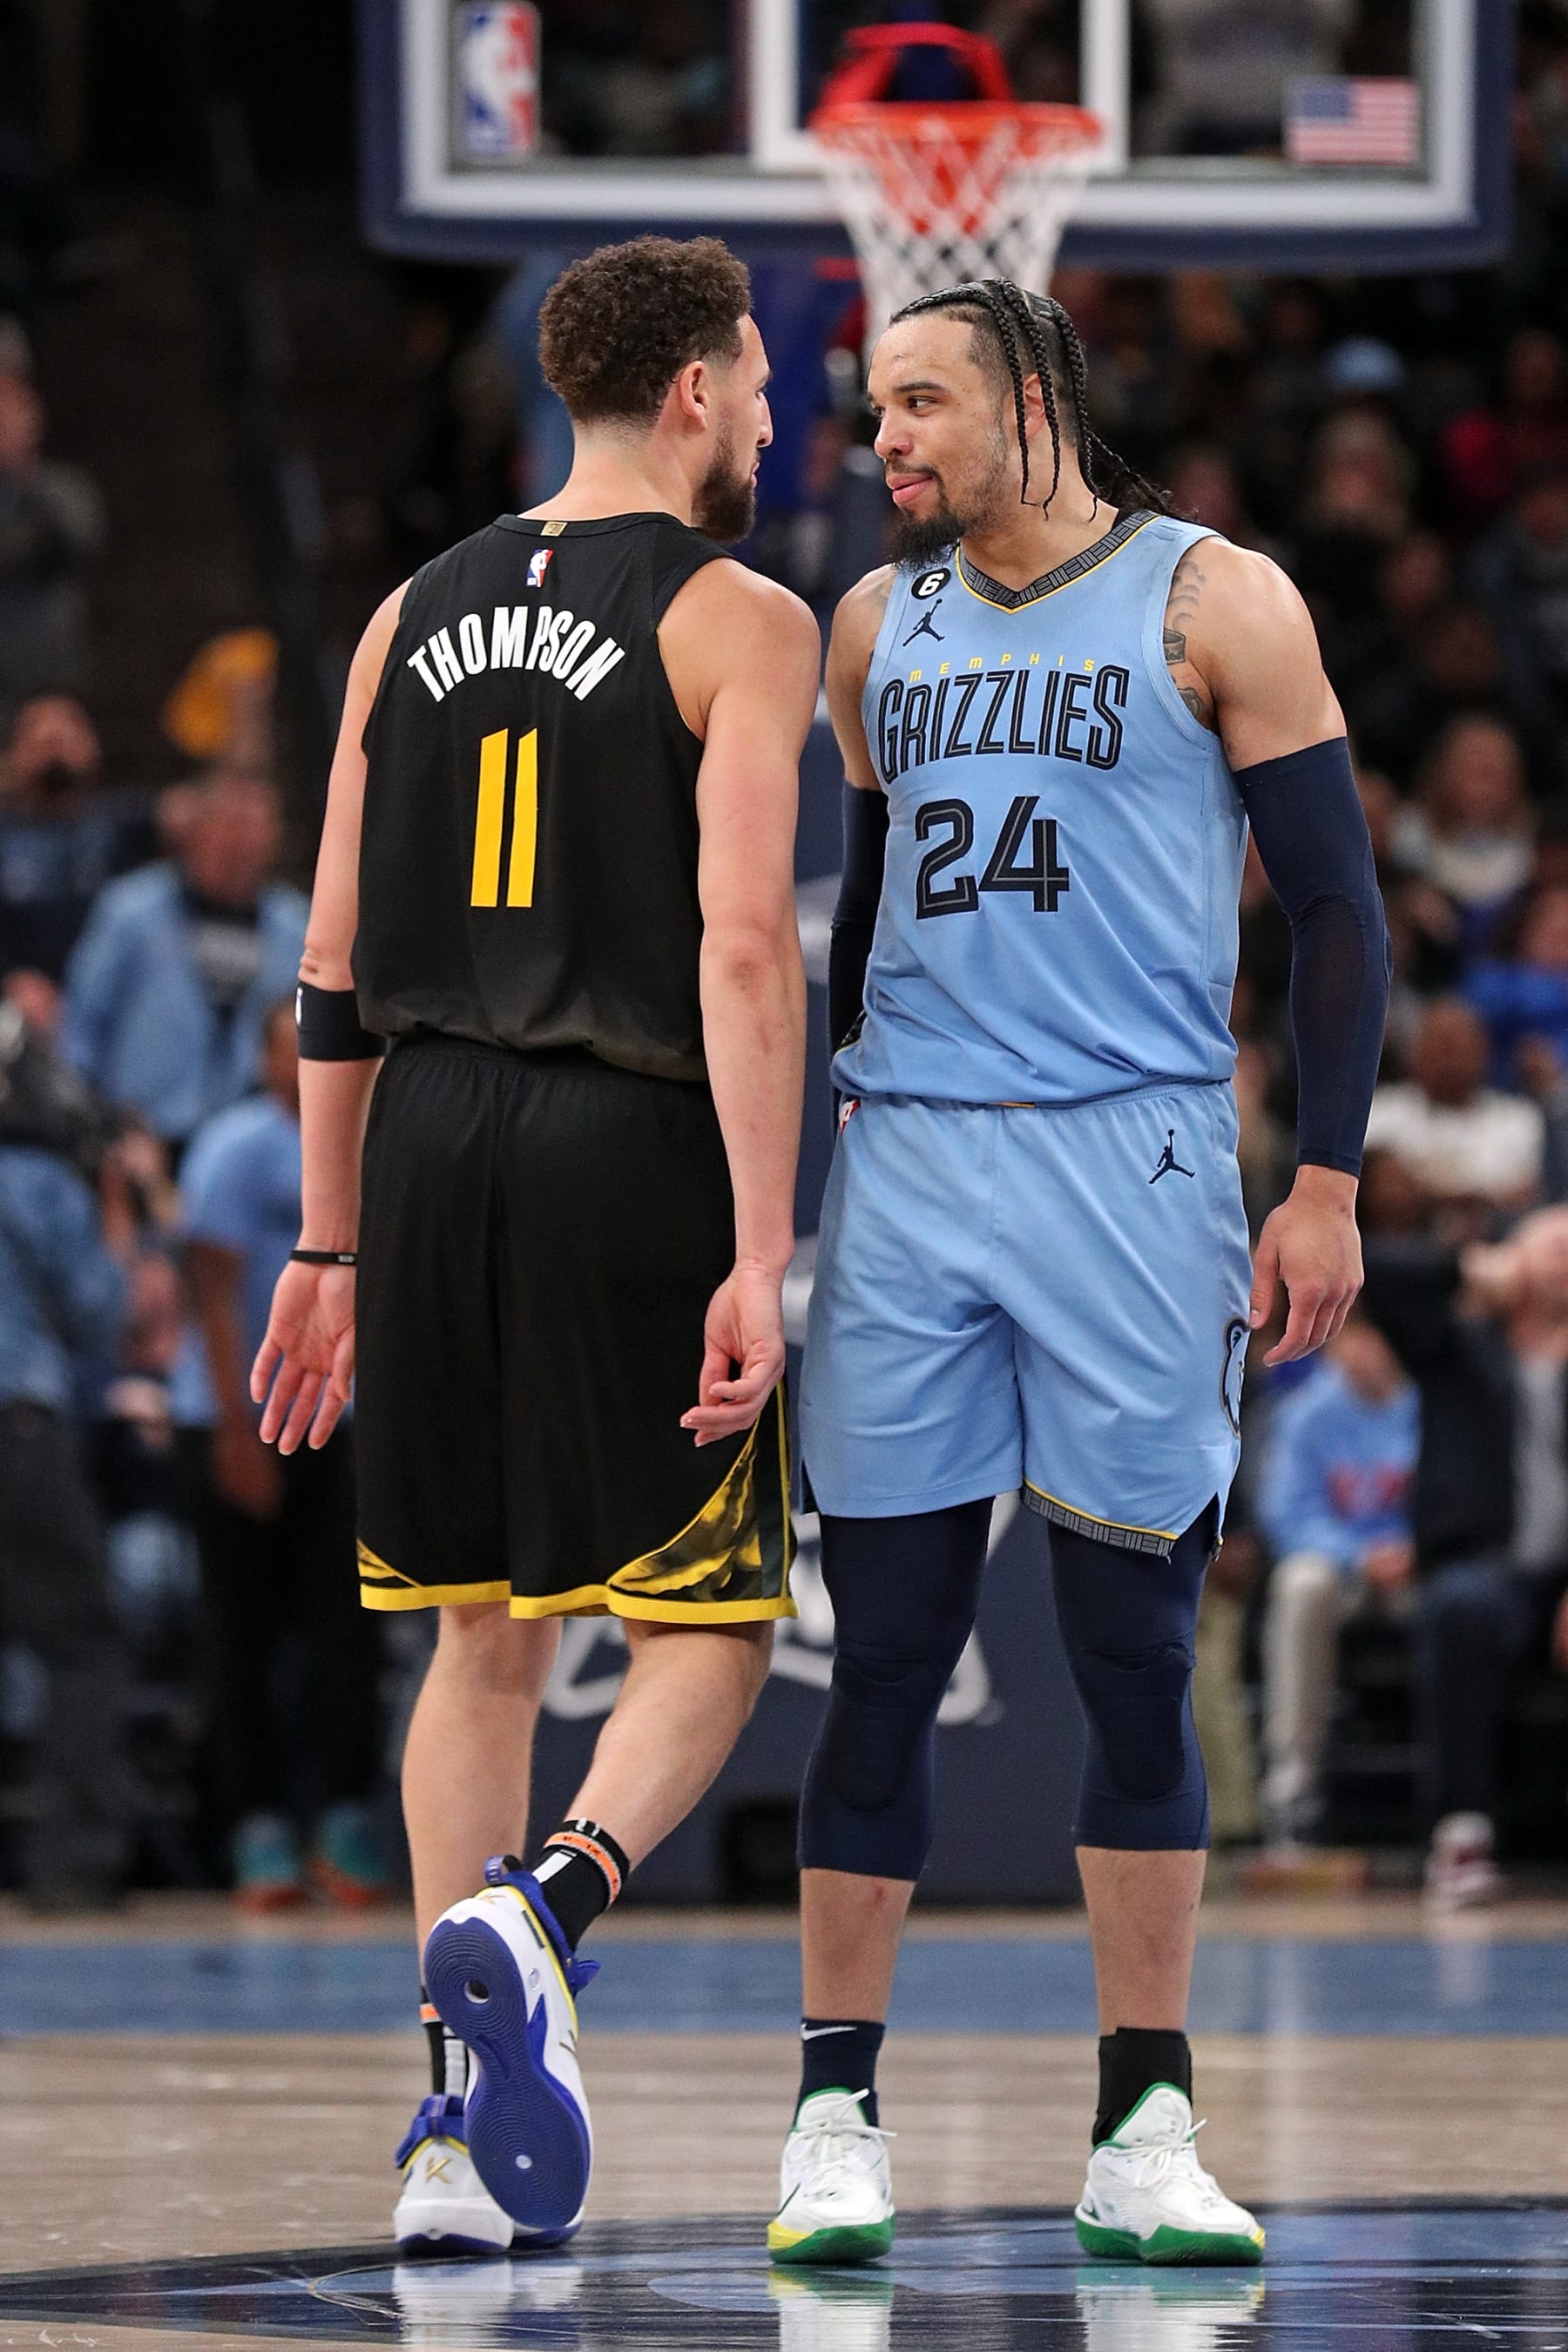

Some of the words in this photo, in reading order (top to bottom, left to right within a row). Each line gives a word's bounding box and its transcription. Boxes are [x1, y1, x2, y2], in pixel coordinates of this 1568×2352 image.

[918, 572, 944, 596] 6
[407, 605, 625, 703] THOMPSON
[909, 652, 1095, 684] MEMPHIS
[877, 665, 1130, 785] GRIZZLIES
[470, 727, 537, 908] 11
[916, 795, 1070, 920] 24
